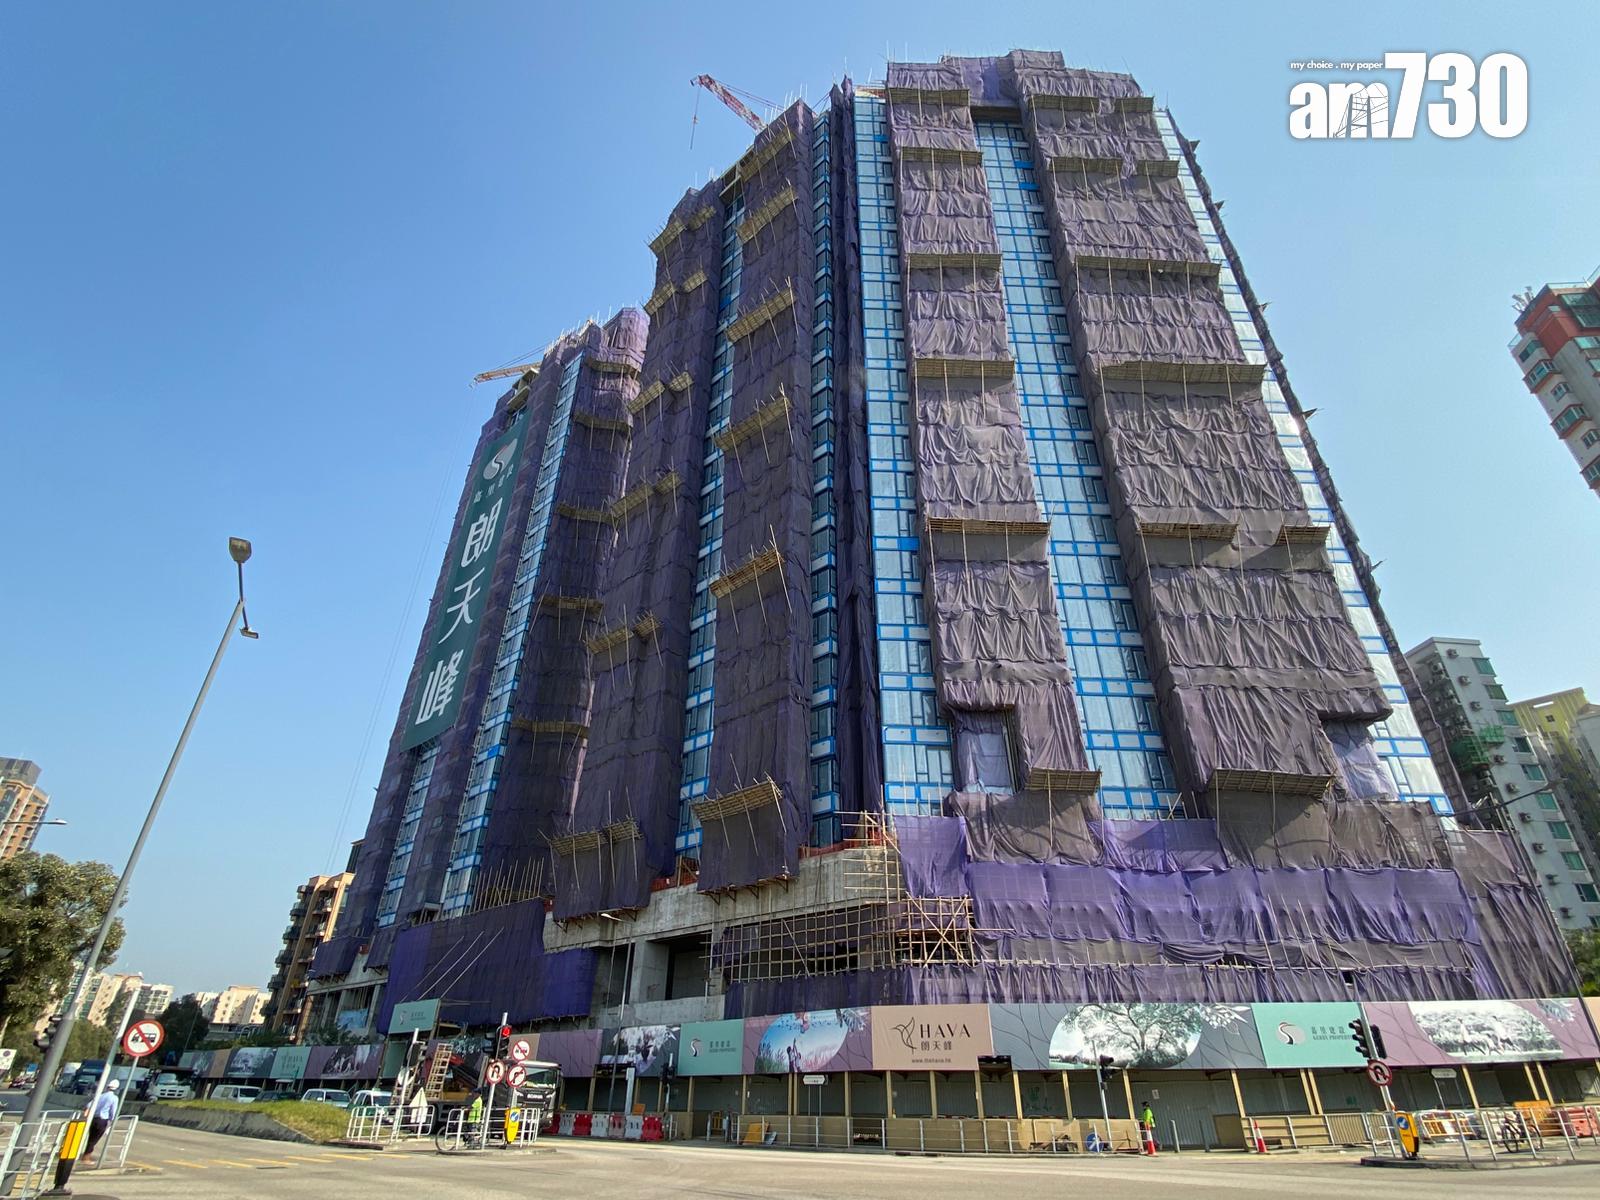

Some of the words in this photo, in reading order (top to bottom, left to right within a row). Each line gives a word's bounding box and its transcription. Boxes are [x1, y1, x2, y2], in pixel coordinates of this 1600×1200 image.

[414, 496, 504, 726] 朗天峰
[920, 1023, 971, 1038] HAVA
